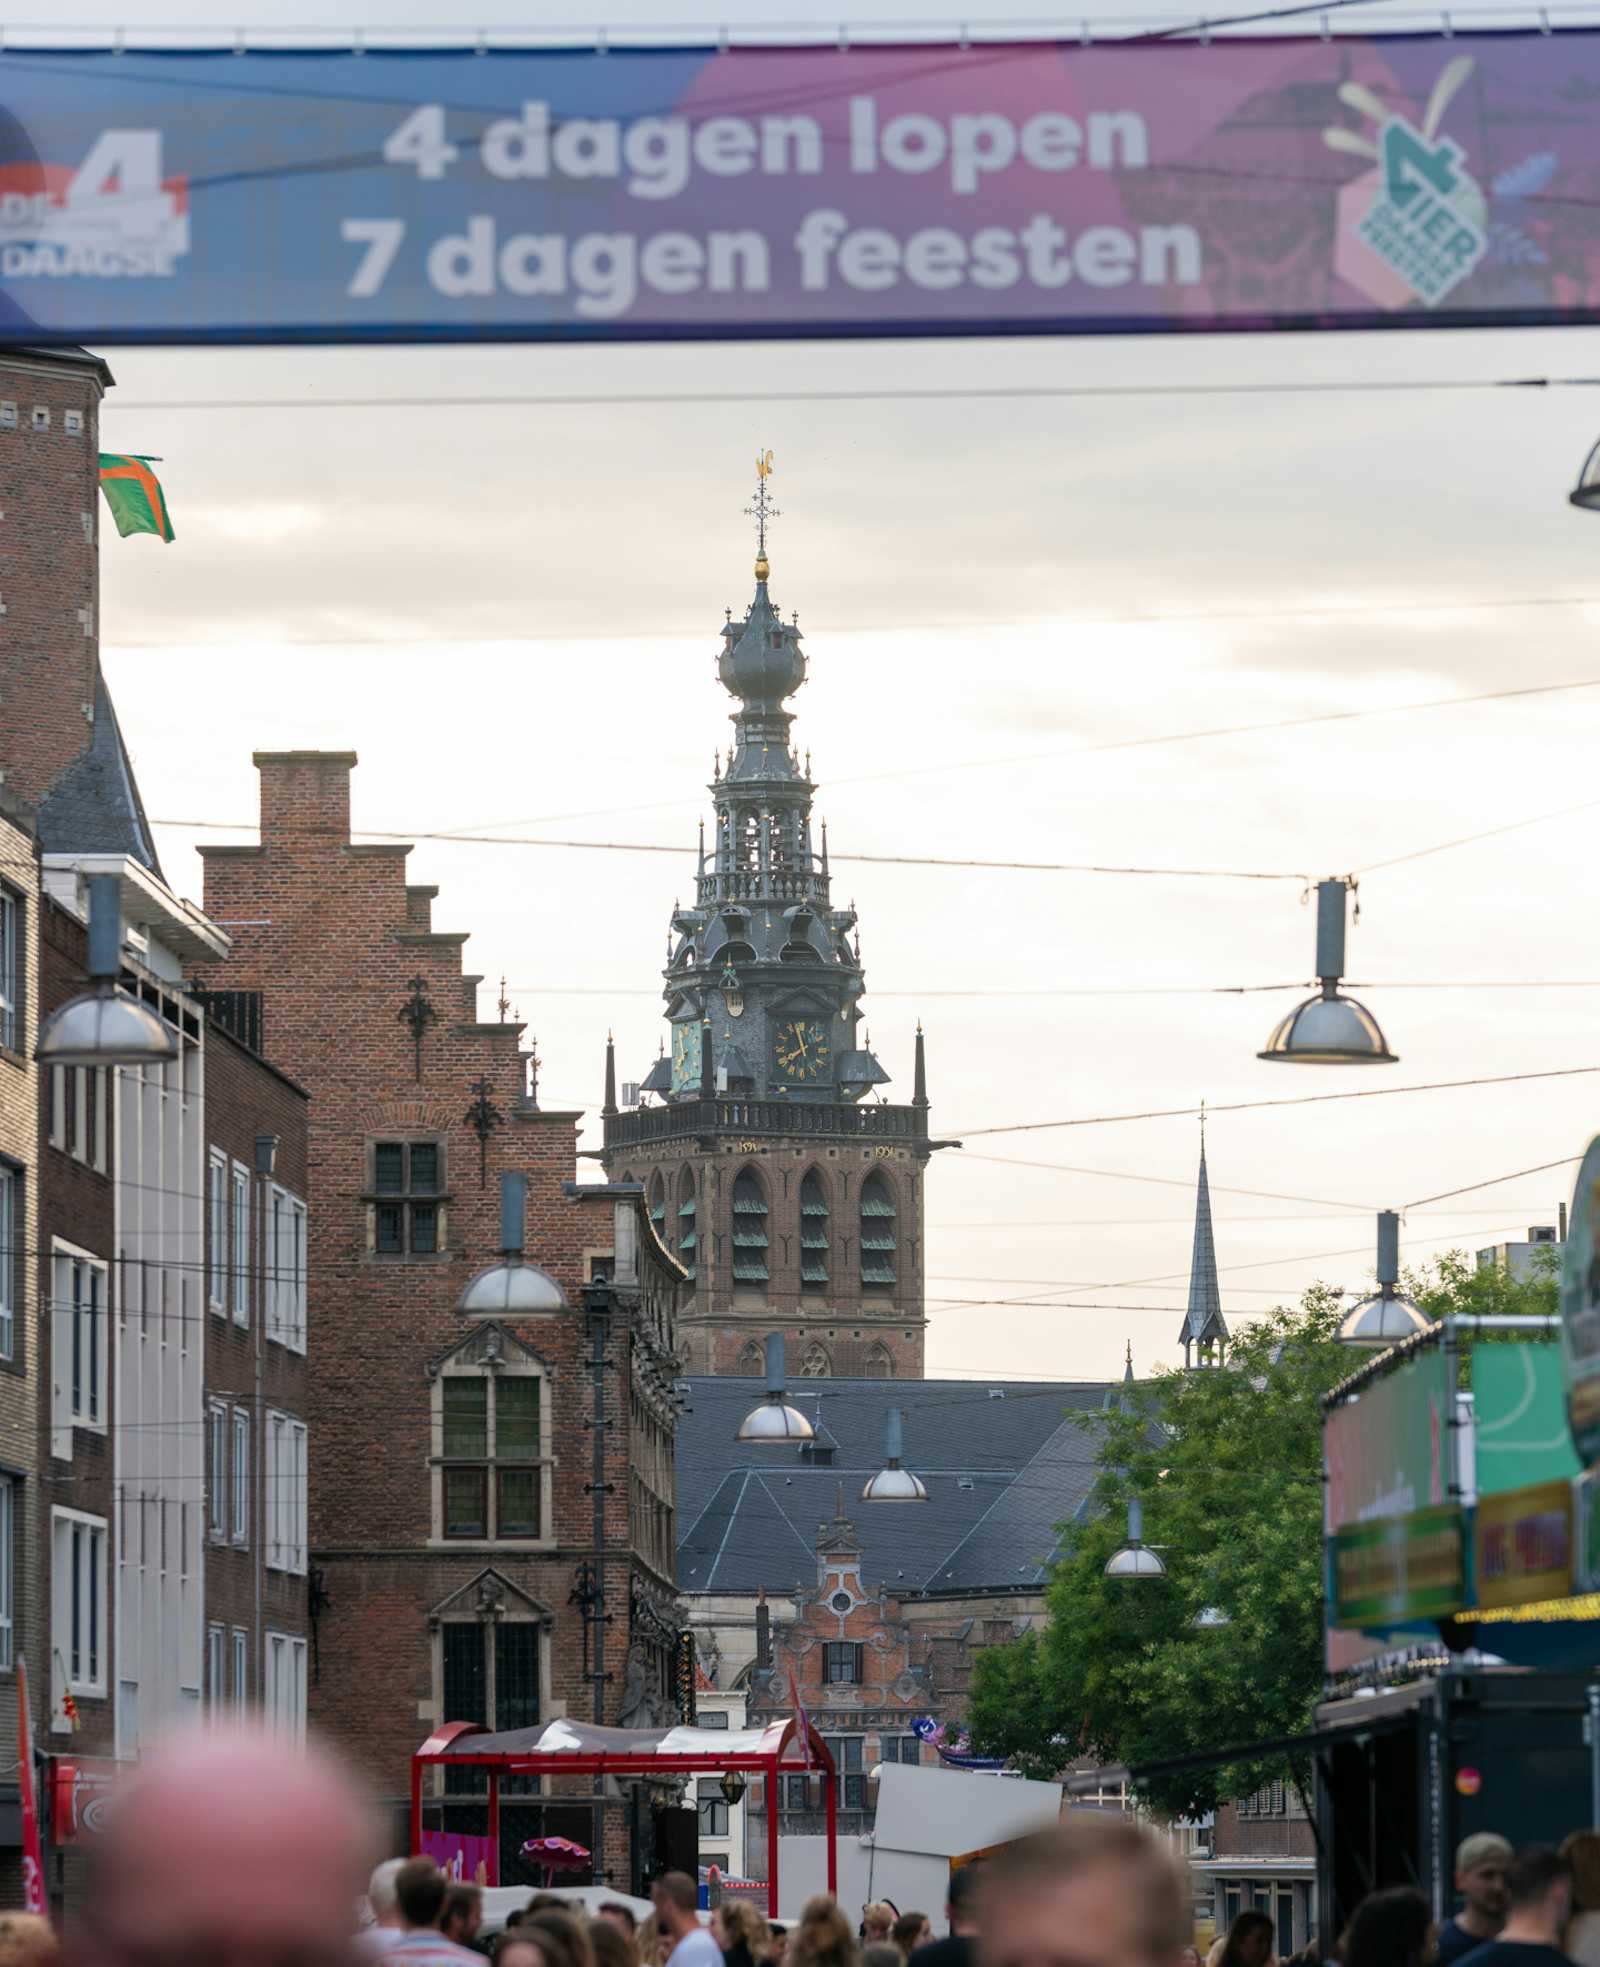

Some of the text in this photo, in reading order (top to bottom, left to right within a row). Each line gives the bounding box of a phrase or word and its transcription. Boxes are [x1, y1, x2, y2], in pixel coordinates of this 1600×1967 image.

[383, 97, 1149, 199] 4 dagen lopen
[2, 249, 176, 277] DAAGSE
[341, 209, 1203, 318] 7 dagen feesten
